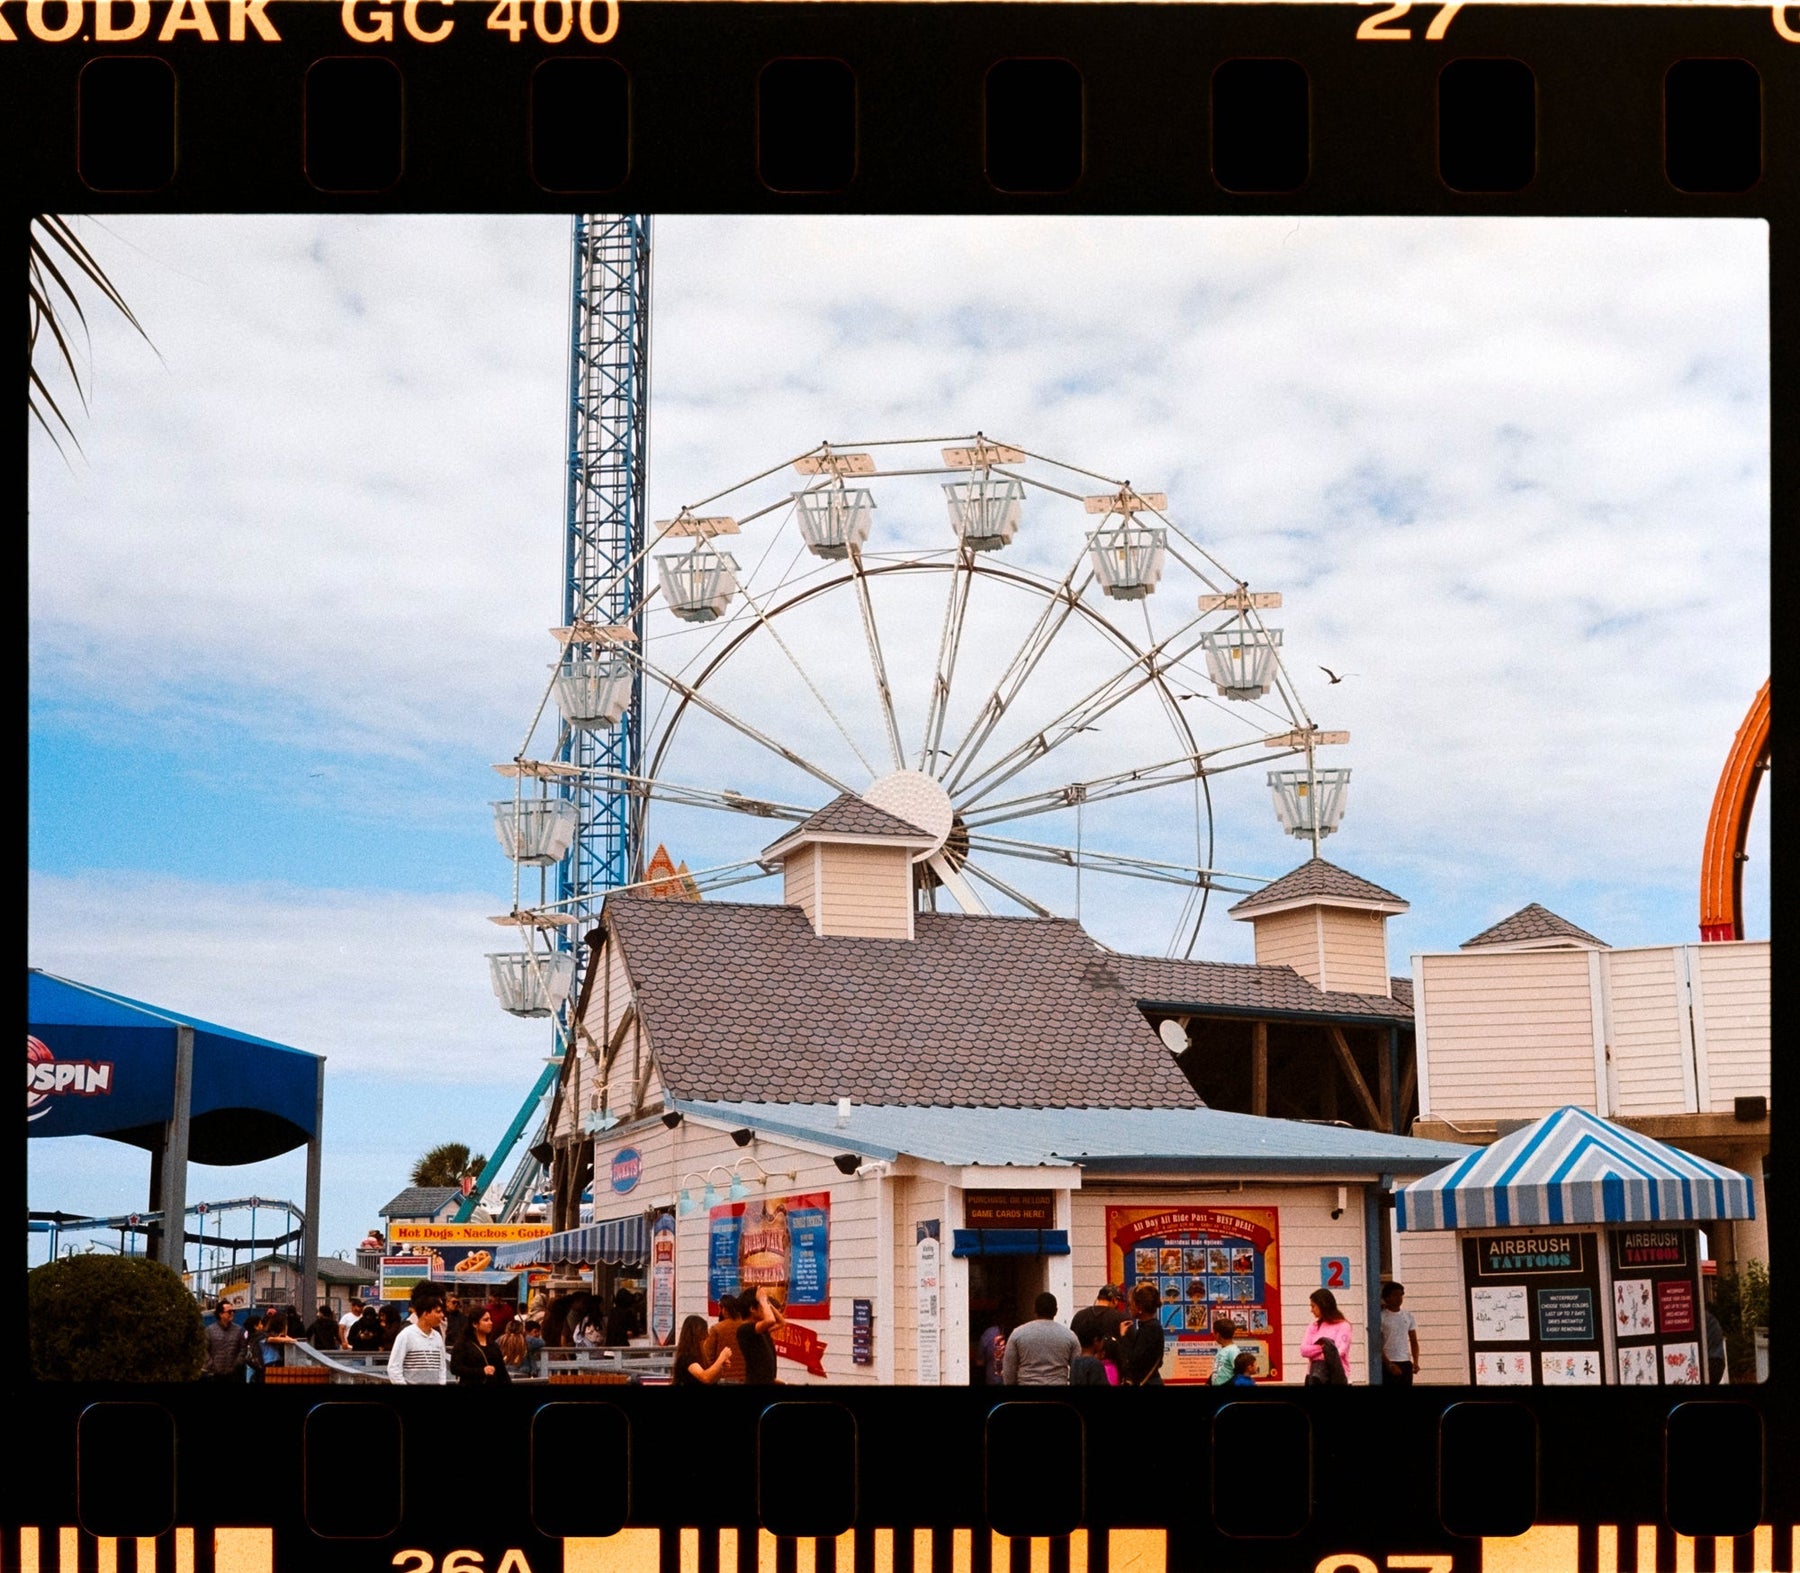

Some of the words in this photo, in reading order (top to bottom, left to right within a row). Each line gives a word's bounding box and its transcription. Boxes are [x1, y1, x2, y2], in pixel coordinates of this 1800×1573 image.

[341, 0, 455, 43] GC
[487, 0, 620, 43] 400
[968, 1195, 1006, 1204] PURCHASE
[1009, 1195, 1020, 1204] OR
[1023, 1195, 1050, 1204] RELOAD
[971, 1210, 993, 1218] GAME
[996, 1210, 1021, 1218] CARDS
[1023, 1210, 1045, 1218] HERE!
[1133, 1222, 1144, 1232] All
[1145, 1219, 1158, 1228] Day
[1161, 1216, 1171, 1225] All
[1172, 1213, 1189, 1223] Ride
[1191, 1213, 1207, 1222] Pass
[1216, 1215, 1233, 1226] BEST
[1235, 1219, 1255, 1232] DEAL!
[398, 1228, 421, 1238] Hot
[424, 1228, 453, 1240] Dogs
[464, 1228, 507, 1238] Nachos
[1625, 1233, 1678, 1247] AIRBRUSH
[1489, 1238, 1571, 1255] AIRBRUSH
[1489, 1254, 1571, 1269] TATTOOS
[1625, 1248, 1679, 1262] TATTOOS
[1328, 1261, 1344, 1287] 2
